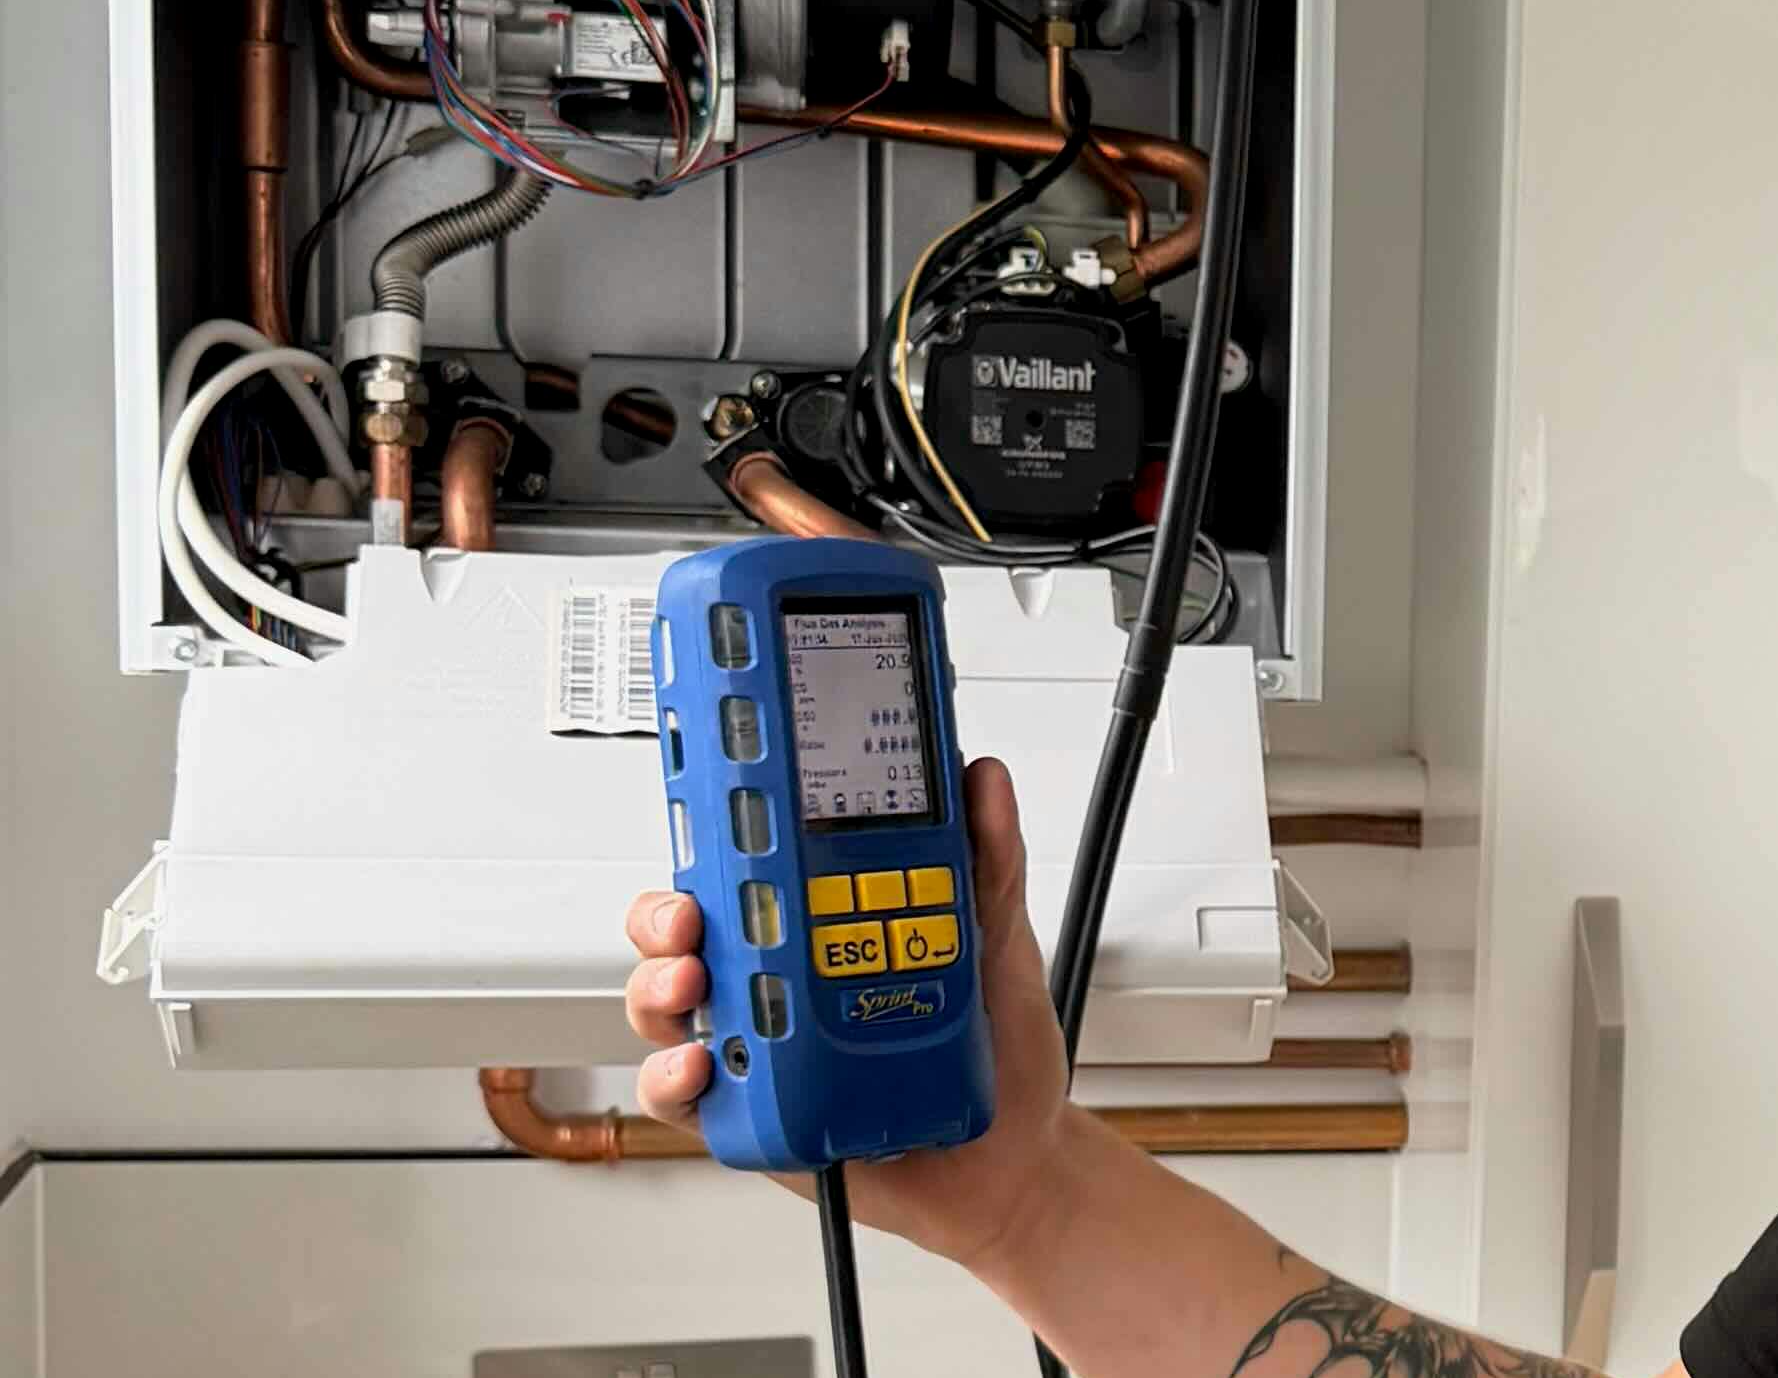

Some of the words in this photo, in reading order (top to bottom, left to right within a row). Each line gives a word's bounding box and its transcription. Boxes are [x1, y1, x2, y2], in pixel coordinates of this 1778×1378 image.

[999, 356, 1096, 391] Vaillant
[875, 654, 911, 669] 20.9
[825, 938, 879, 967] ESC
[850, 983, 918, 1021] Sprint
[912, 1001, 935, 1015] Pro
